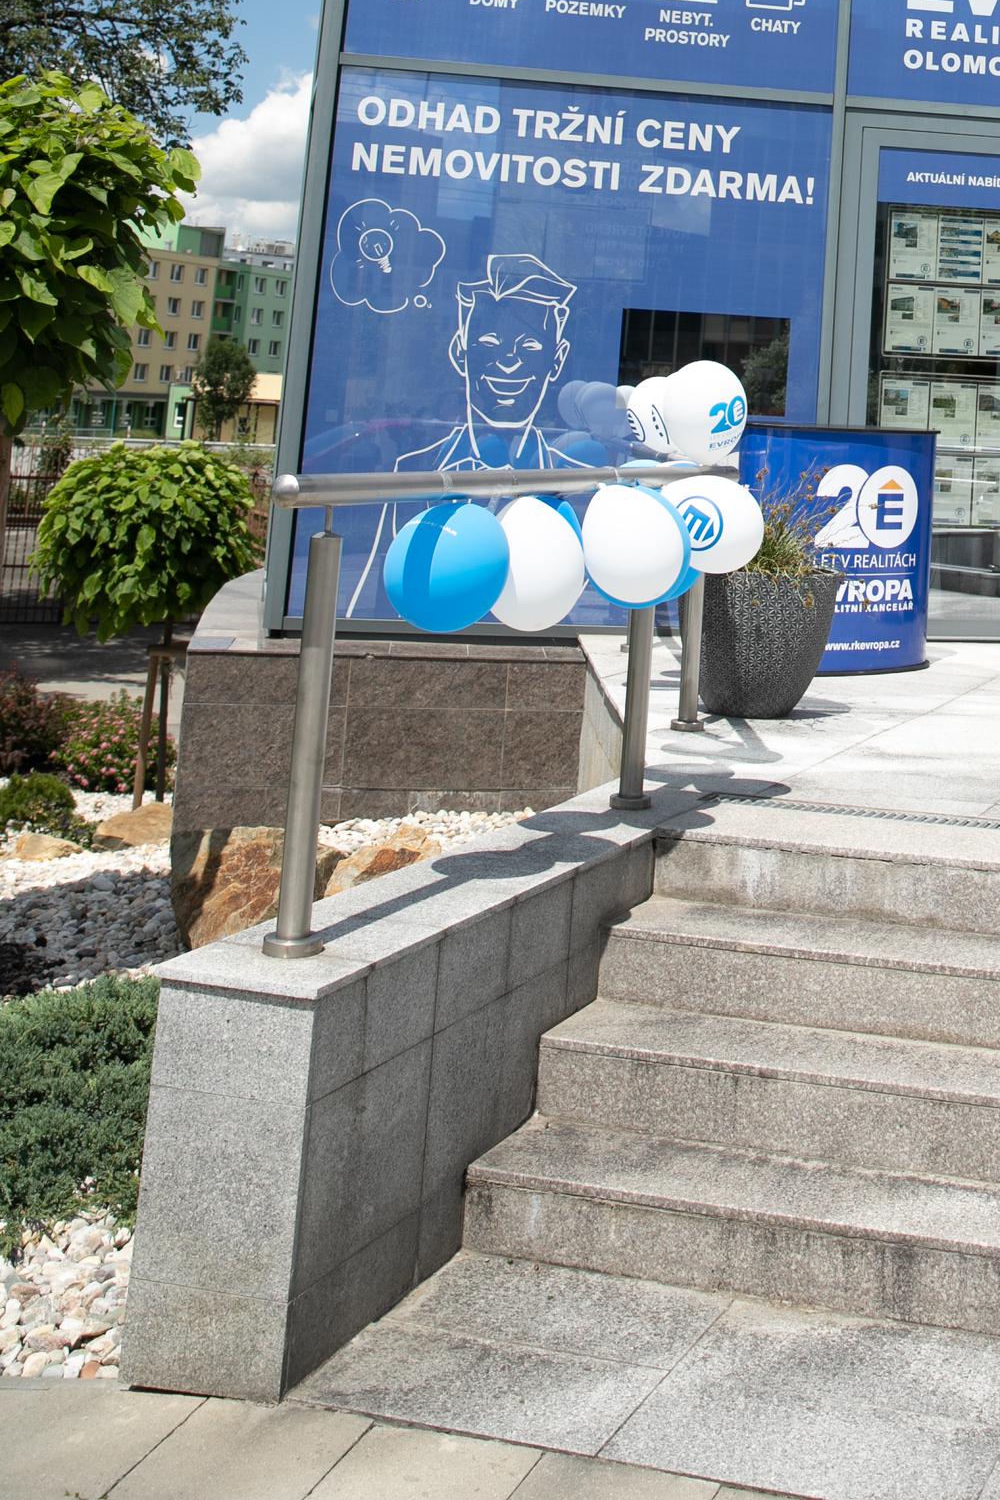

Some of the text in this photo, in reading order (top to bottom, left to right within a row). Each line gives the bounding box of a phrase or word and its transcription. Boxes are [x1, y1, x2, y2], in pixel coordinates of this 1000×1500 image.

[545, 0, 627, 19] POZEMKY
[659, 9, 714, 27] NEBYT.
[750, 18, 802, 35] CHATY
[644, 28, 731, 47] PROSTORY
[356, 96, 742, 154] ODHAD TRŽNÍ CENY
[351, 143, 816, 205] NEMOVITOSTI ZDARMA!
[906, 172, 965, 186] AKTUÁLNÍ
[853, 551, 917, 568] REALITÁCH
[824, 640, 901, 652] www.rkevropa.cz
